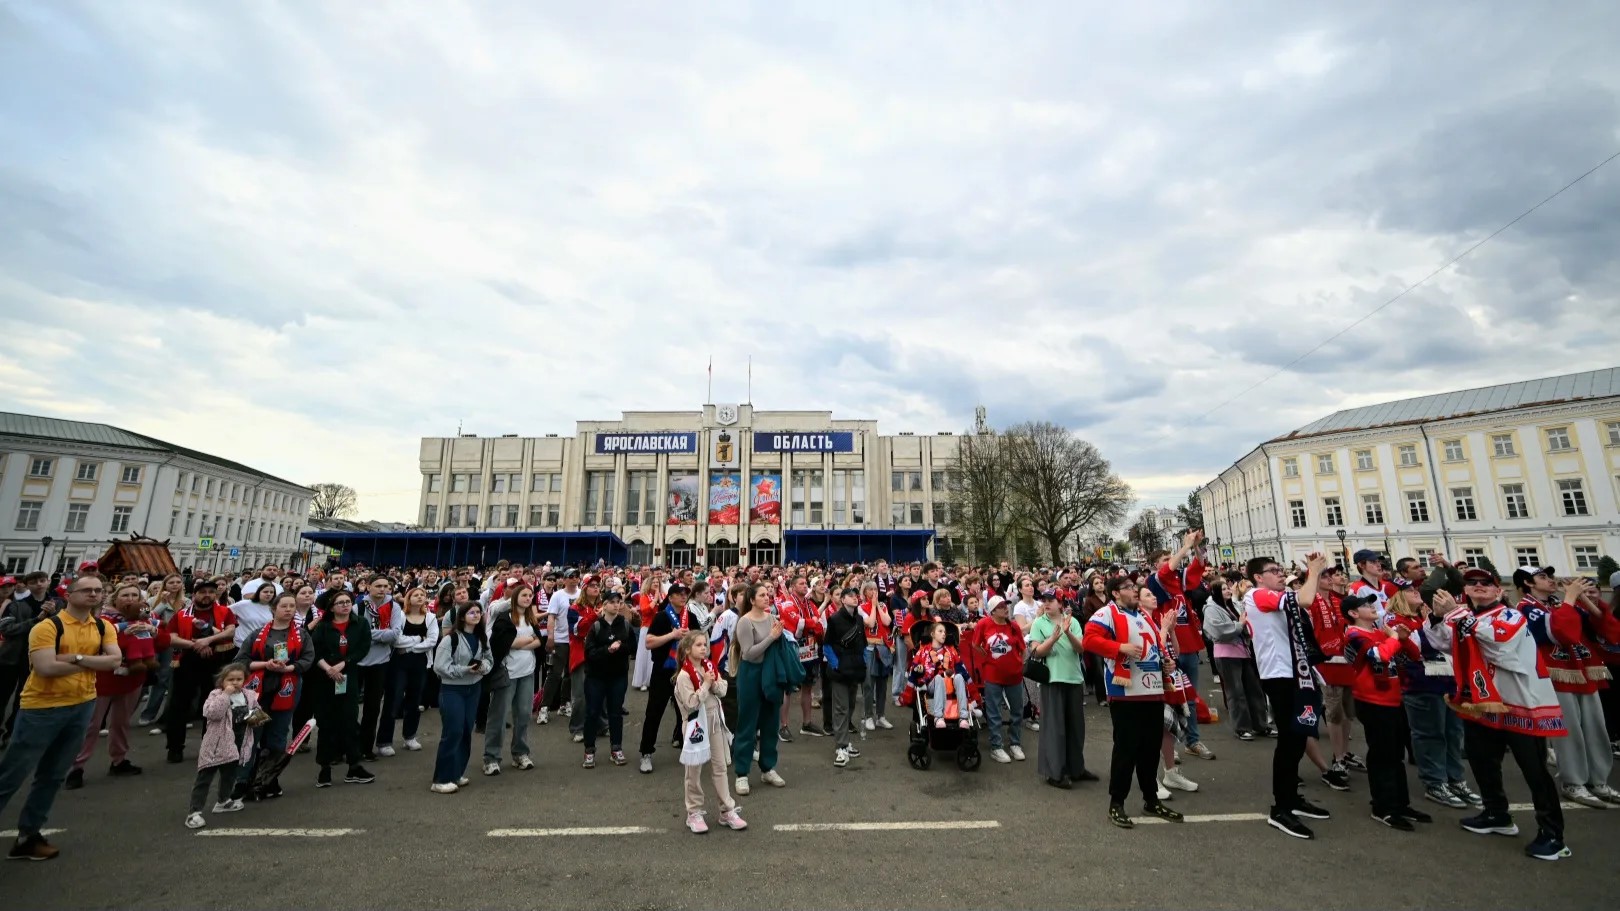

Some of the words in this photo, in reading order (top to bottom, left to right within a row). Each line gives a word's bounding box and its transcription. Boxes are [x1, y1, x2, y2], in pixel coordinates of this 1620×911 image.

[604, 436, 688, 450] ЯРОСЛАВСКАЯ
[773, 435, 833, 450] ОБЛАСТЬ
[1291, 607, 1299, 619] ICE
